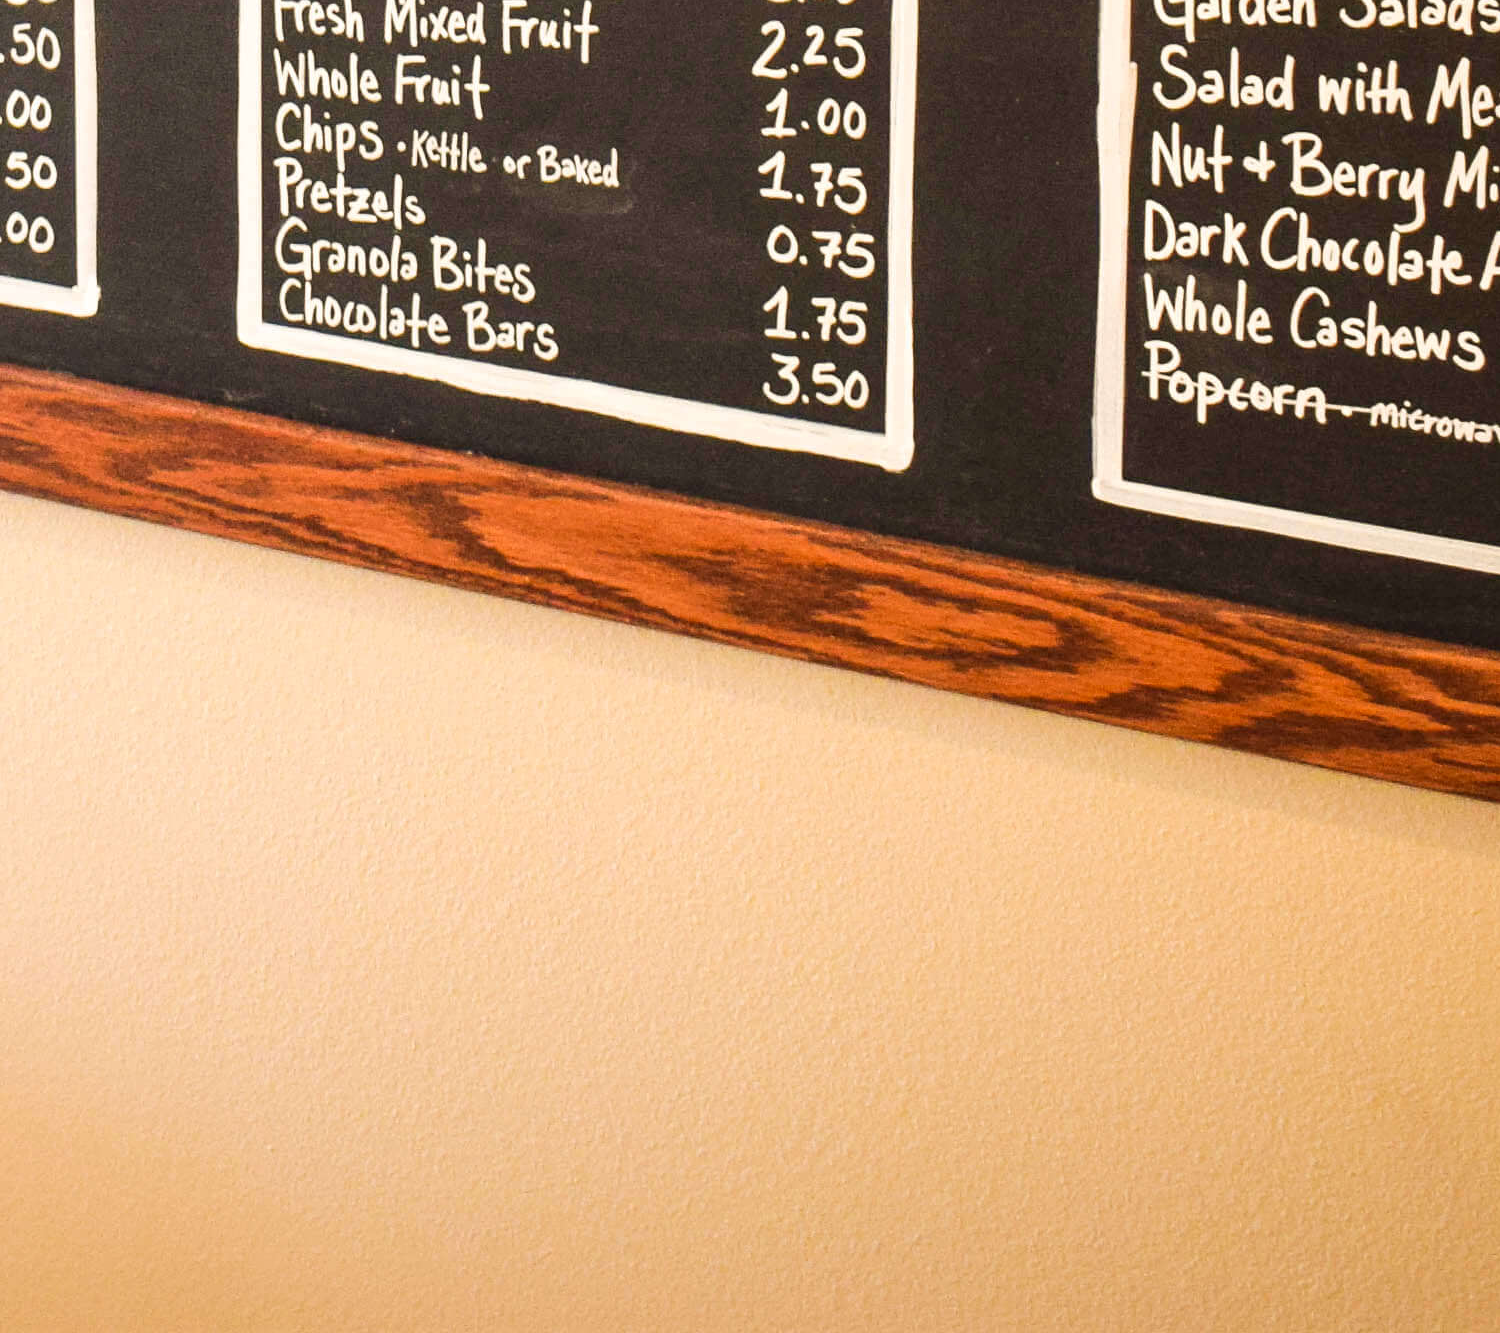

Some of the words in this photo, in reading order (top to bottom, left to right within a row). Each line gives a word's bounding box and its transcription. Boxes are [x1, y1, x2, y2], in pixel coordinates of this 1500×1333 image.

[502, 0, 599, 63] Fruit
[752, 21, 865, 78] 2.25
[1153, 44, 1294, 110] Salad
[1319, 60, 1413, 121] with
[274, 48, 381, 104] Whole
[395, 54, 490, 120] Fruit
[761, 88, 866, 139] 1.00
[275, 102, 385, 171] Chips
[412, 130, 487, 172] Kettle
[503, 155, 531, 179] or
[537, 145, 619, 187] Baked
[758, 151, 867, 214] 1.75
[1152, 122, 1232, 193] Nut
[1281, 131, 1427, 234] Berry
[274, 158, 428, 231] Pretzels
[767, 225, 875, 278] 0.75
[1144, 200, 1248, 266] Dark
[1260, 206, 1472, 290] Chocolate
[274, 216, 419, 282] Granola
[430, 235, 535, 302] Bites
[764, 286, 867, 344] 1.75
[1144, 273, 1272, 344] Whole
[1291, 287, 1485, 371] Cashews
[278, 279, 452, 349] Chocolate
[462, 301, 558, 360] Bars
[763, 353, 869, 408] 3.50
